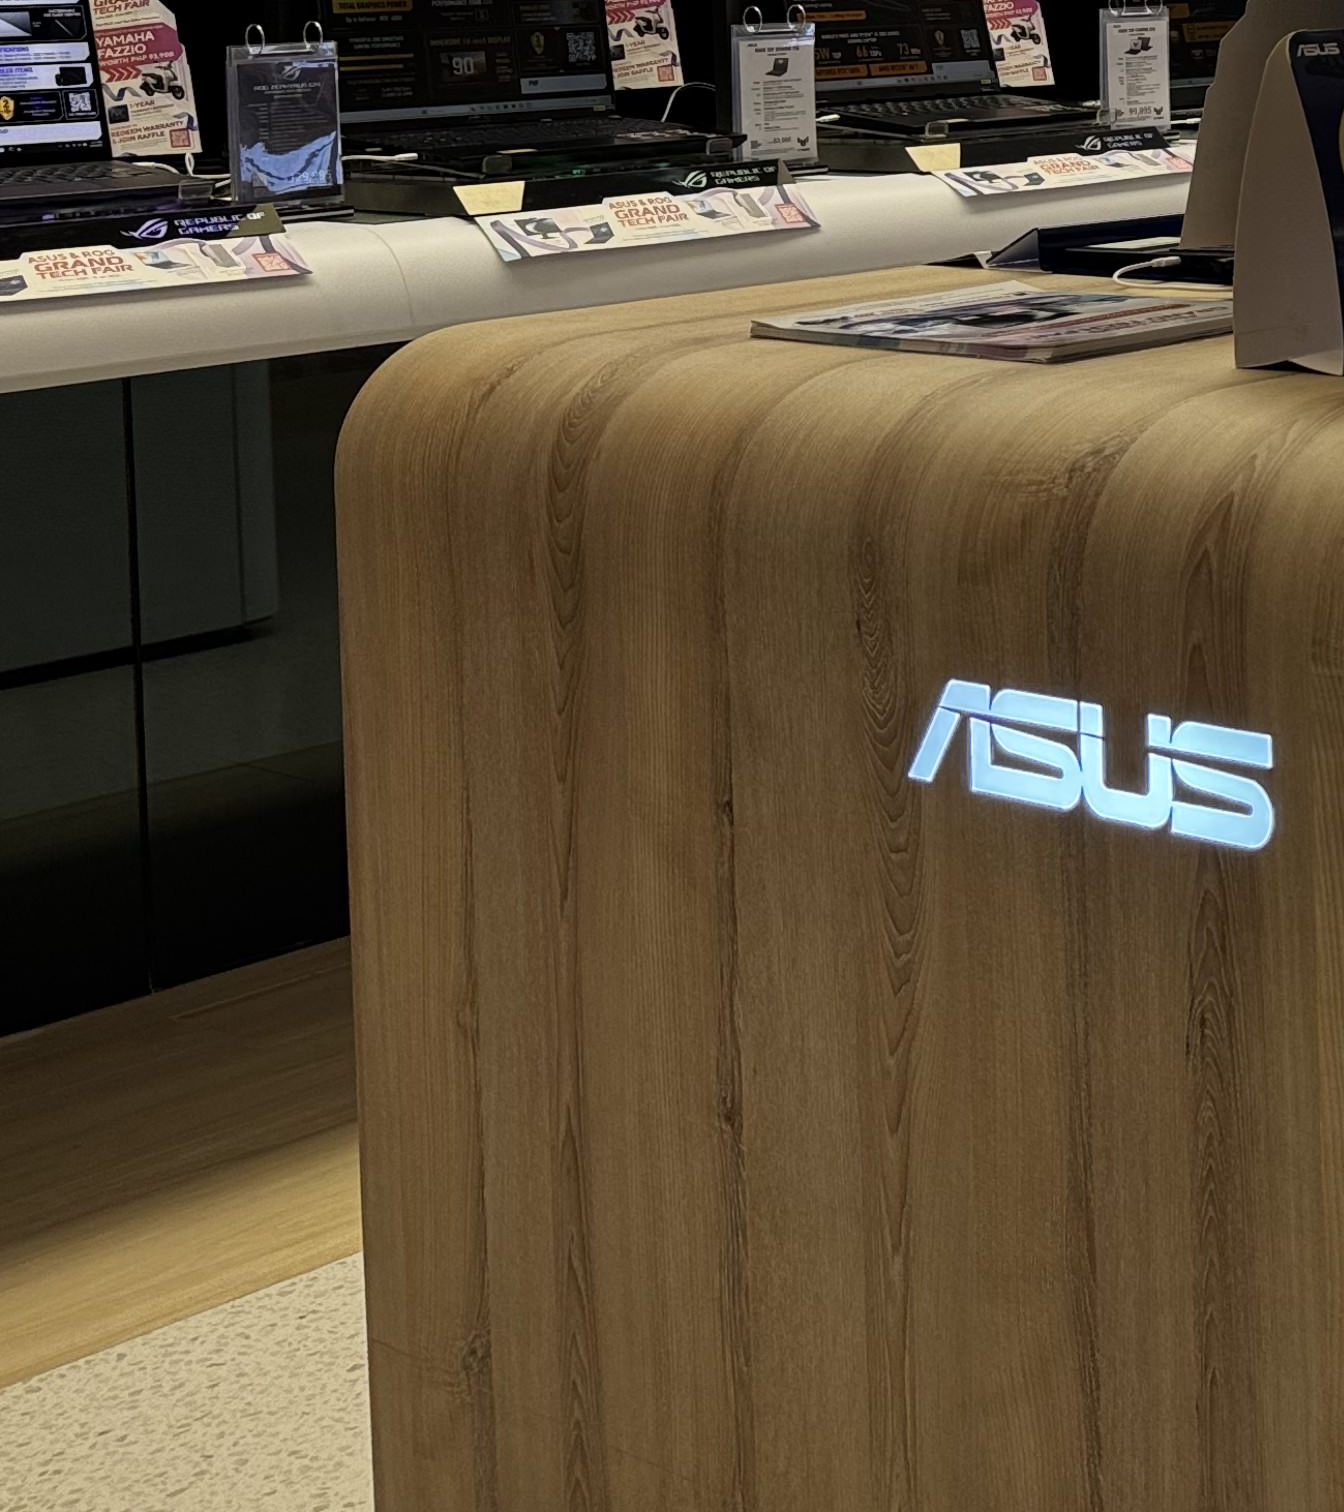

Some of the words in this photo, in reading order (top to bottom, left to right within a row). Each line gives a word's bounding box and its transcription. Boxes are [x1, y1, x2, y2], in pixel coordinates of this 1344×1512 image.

[94, 4, 122, 15] TECH
[124, 0, 150, 10] FAIR
[96, 31, 155, 46] YAMAHA
[98, 44, 147, 58] FAZZIO
[1297, 42, 1341, 58] ASUS
[614, 203, 681, 219] GRAND
[174, 214, 244, 228] REPUBLIC
[247, 212, 265, 220] OF
[617, 216, 656, 227] TECH
[657, 212, 689, 224] FAIR
[178, 223, 240, 234] GAMERS
[28, 253, 70, 264] ASUS
[83, 249, 115, 258] ROG
[34, 256, 124, 272] GRAND
[36, 267, 87, 280] TECH
[92, 263, 134, 274] FAIR
[907, 678, 1274, 850] ASUS
